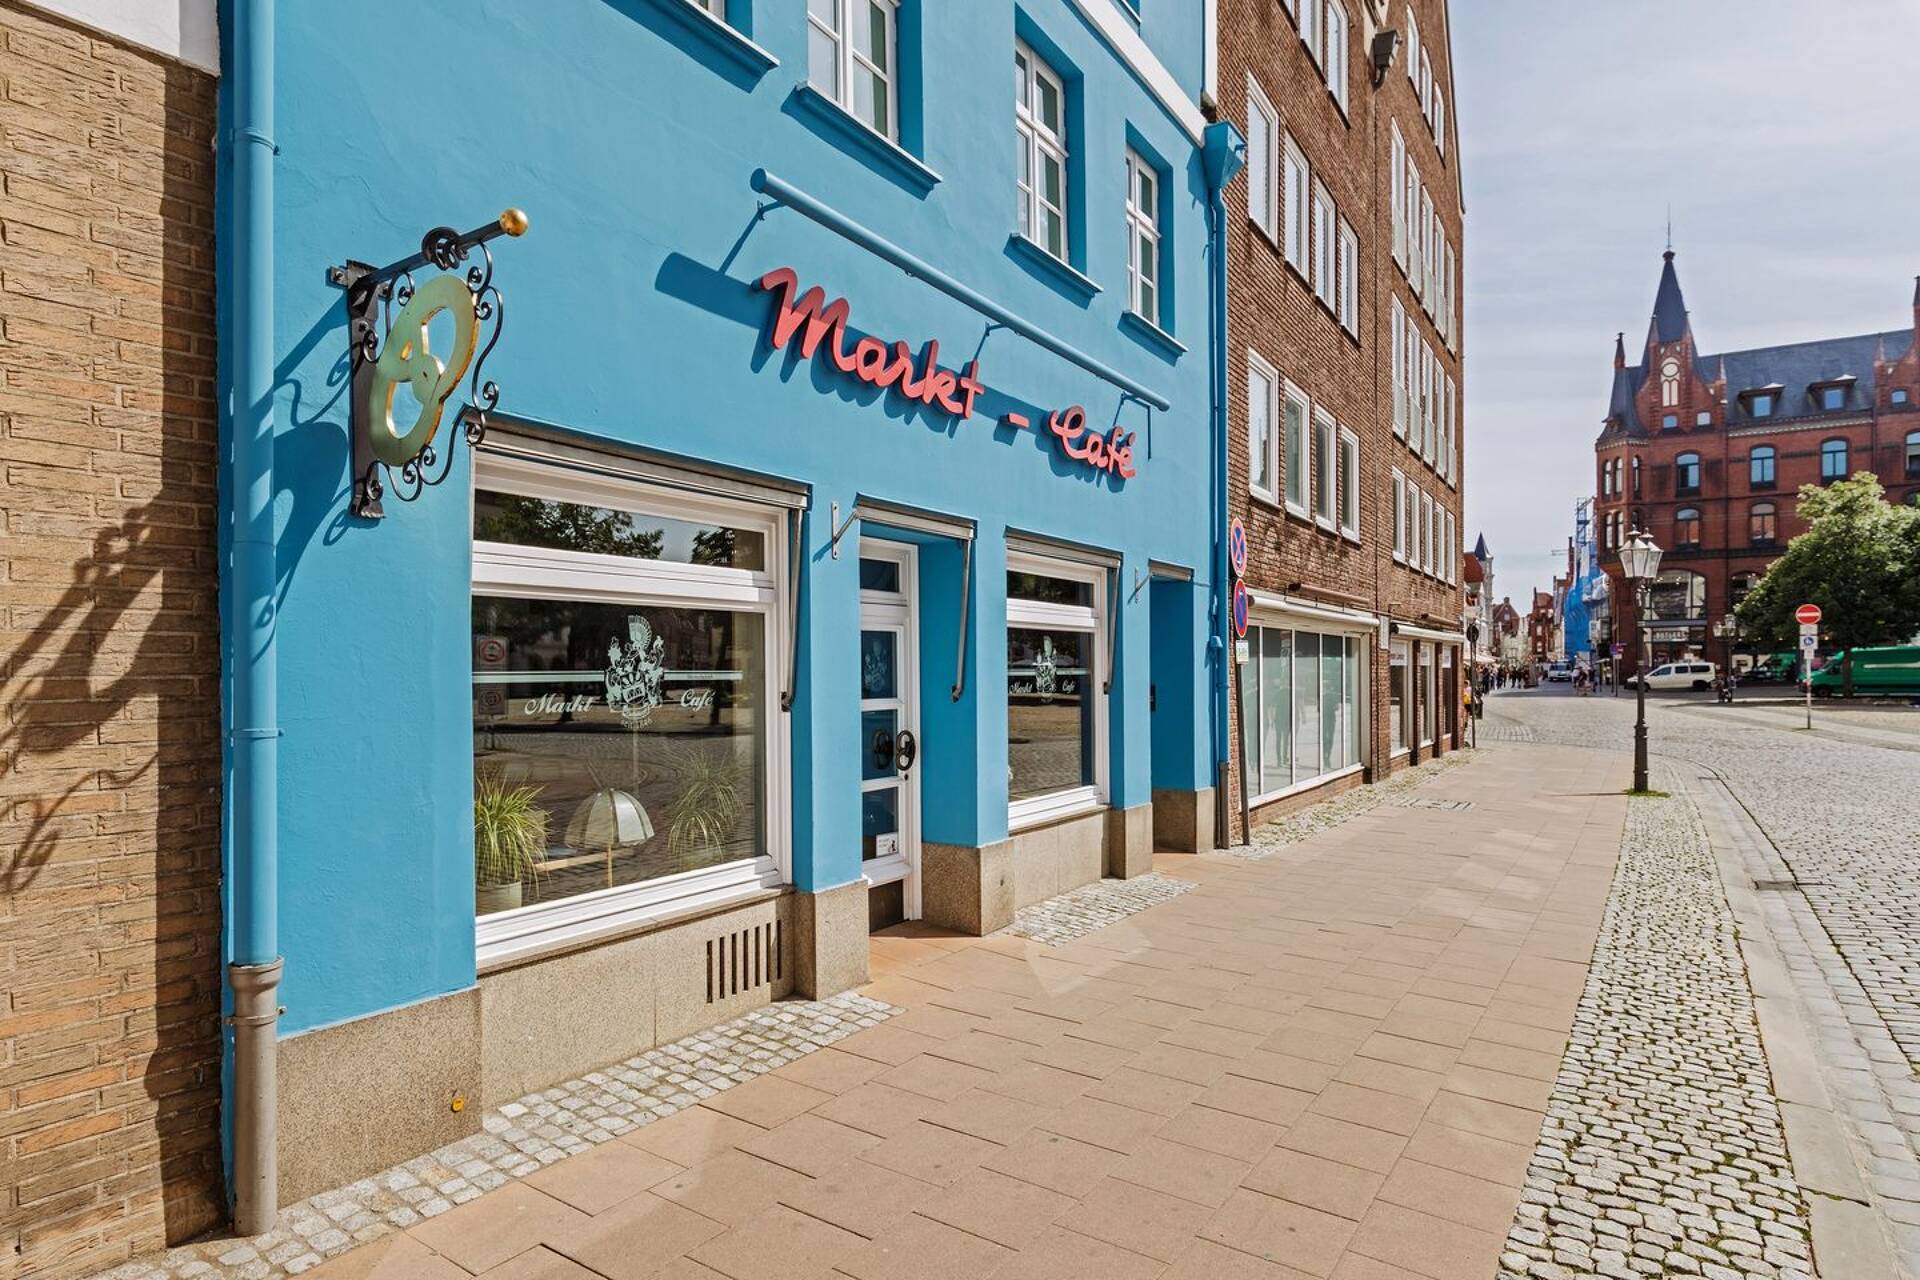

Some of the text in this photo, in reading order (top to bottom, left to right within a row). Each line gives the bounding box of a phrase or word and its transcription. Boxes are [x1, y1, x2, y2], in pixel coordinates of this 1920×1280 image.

[759, 266, 985, 420] Markt
[1049, 404, 1137, 479] Café
[524, 688, 717, 715] Markt Café
